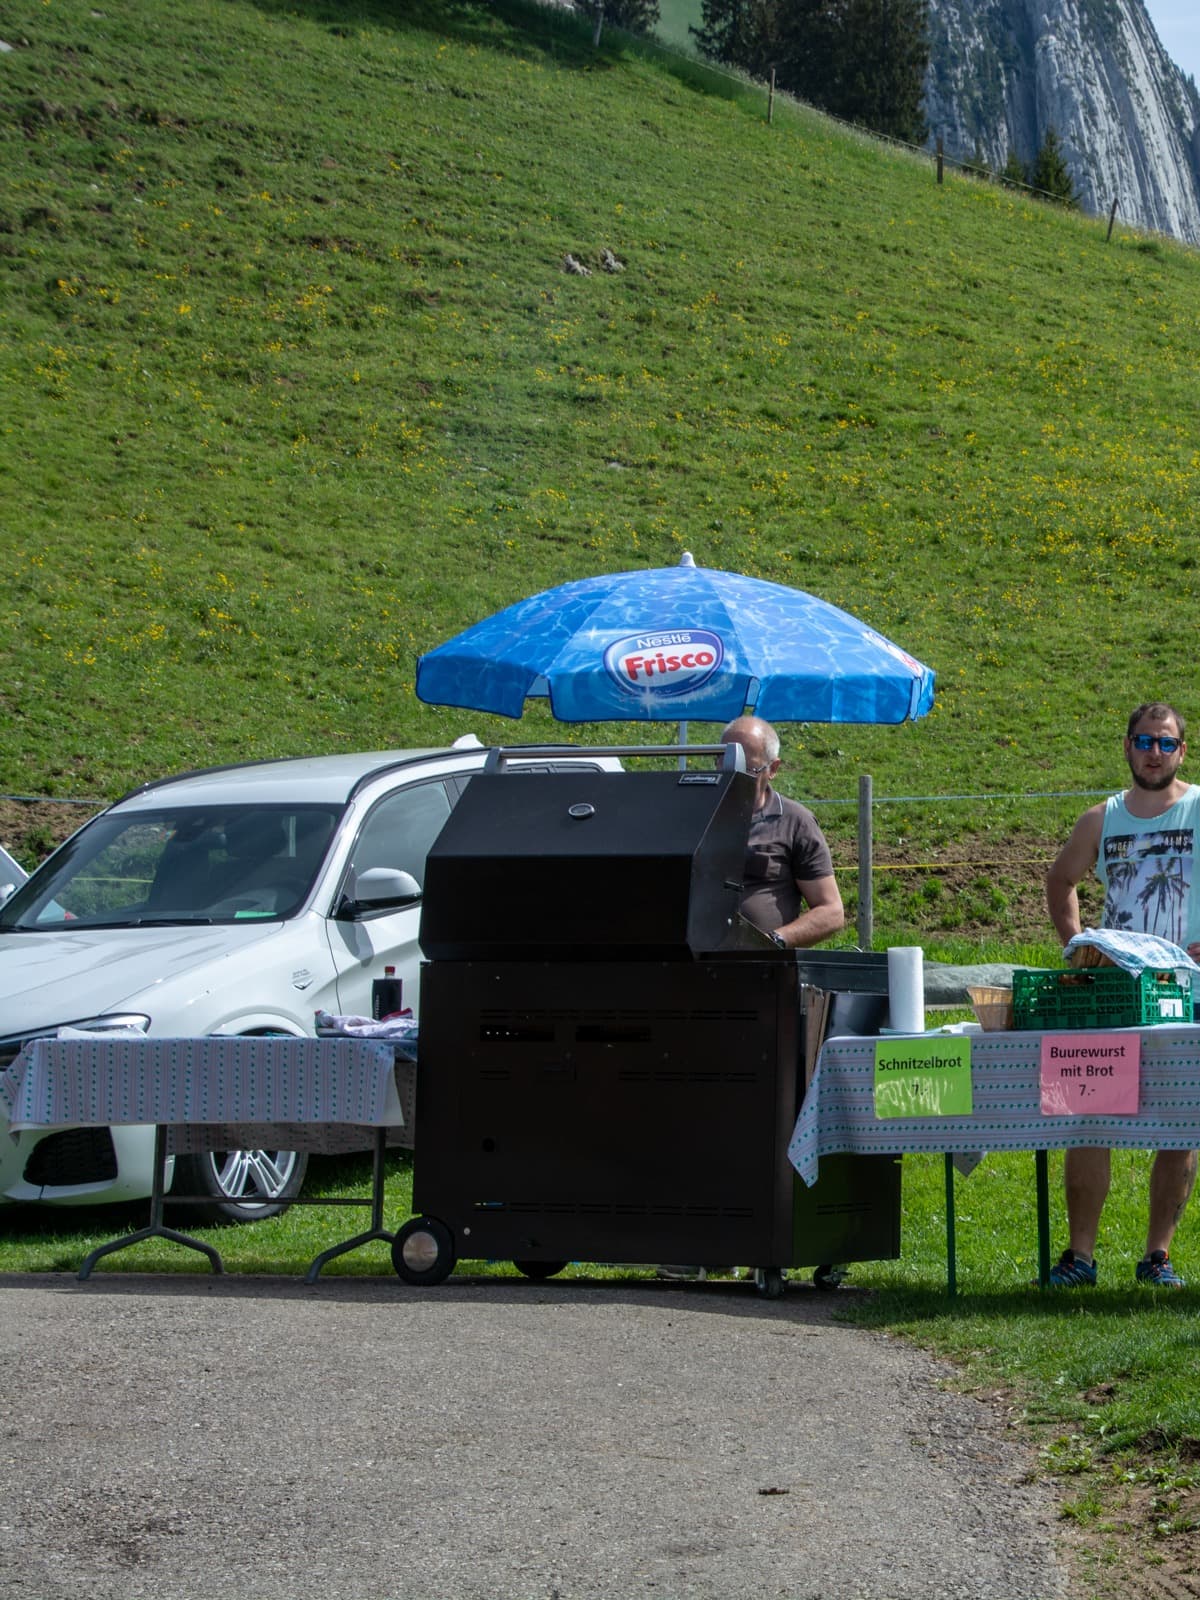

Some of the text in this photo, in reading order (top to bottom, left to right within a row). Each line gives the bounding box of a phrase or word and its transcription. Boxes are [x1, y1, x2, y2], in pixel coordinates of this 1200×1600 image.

[625, 652, 714, 681] Frisco
[1050, 1046, 1125, 1058] Buurewurst
[878, 1056, 962, 1071] Schnitzelbrot
[1060, 1064, 1114, 1077] mit Brot
[1079, 1084, 1096, 1096] 7.-
